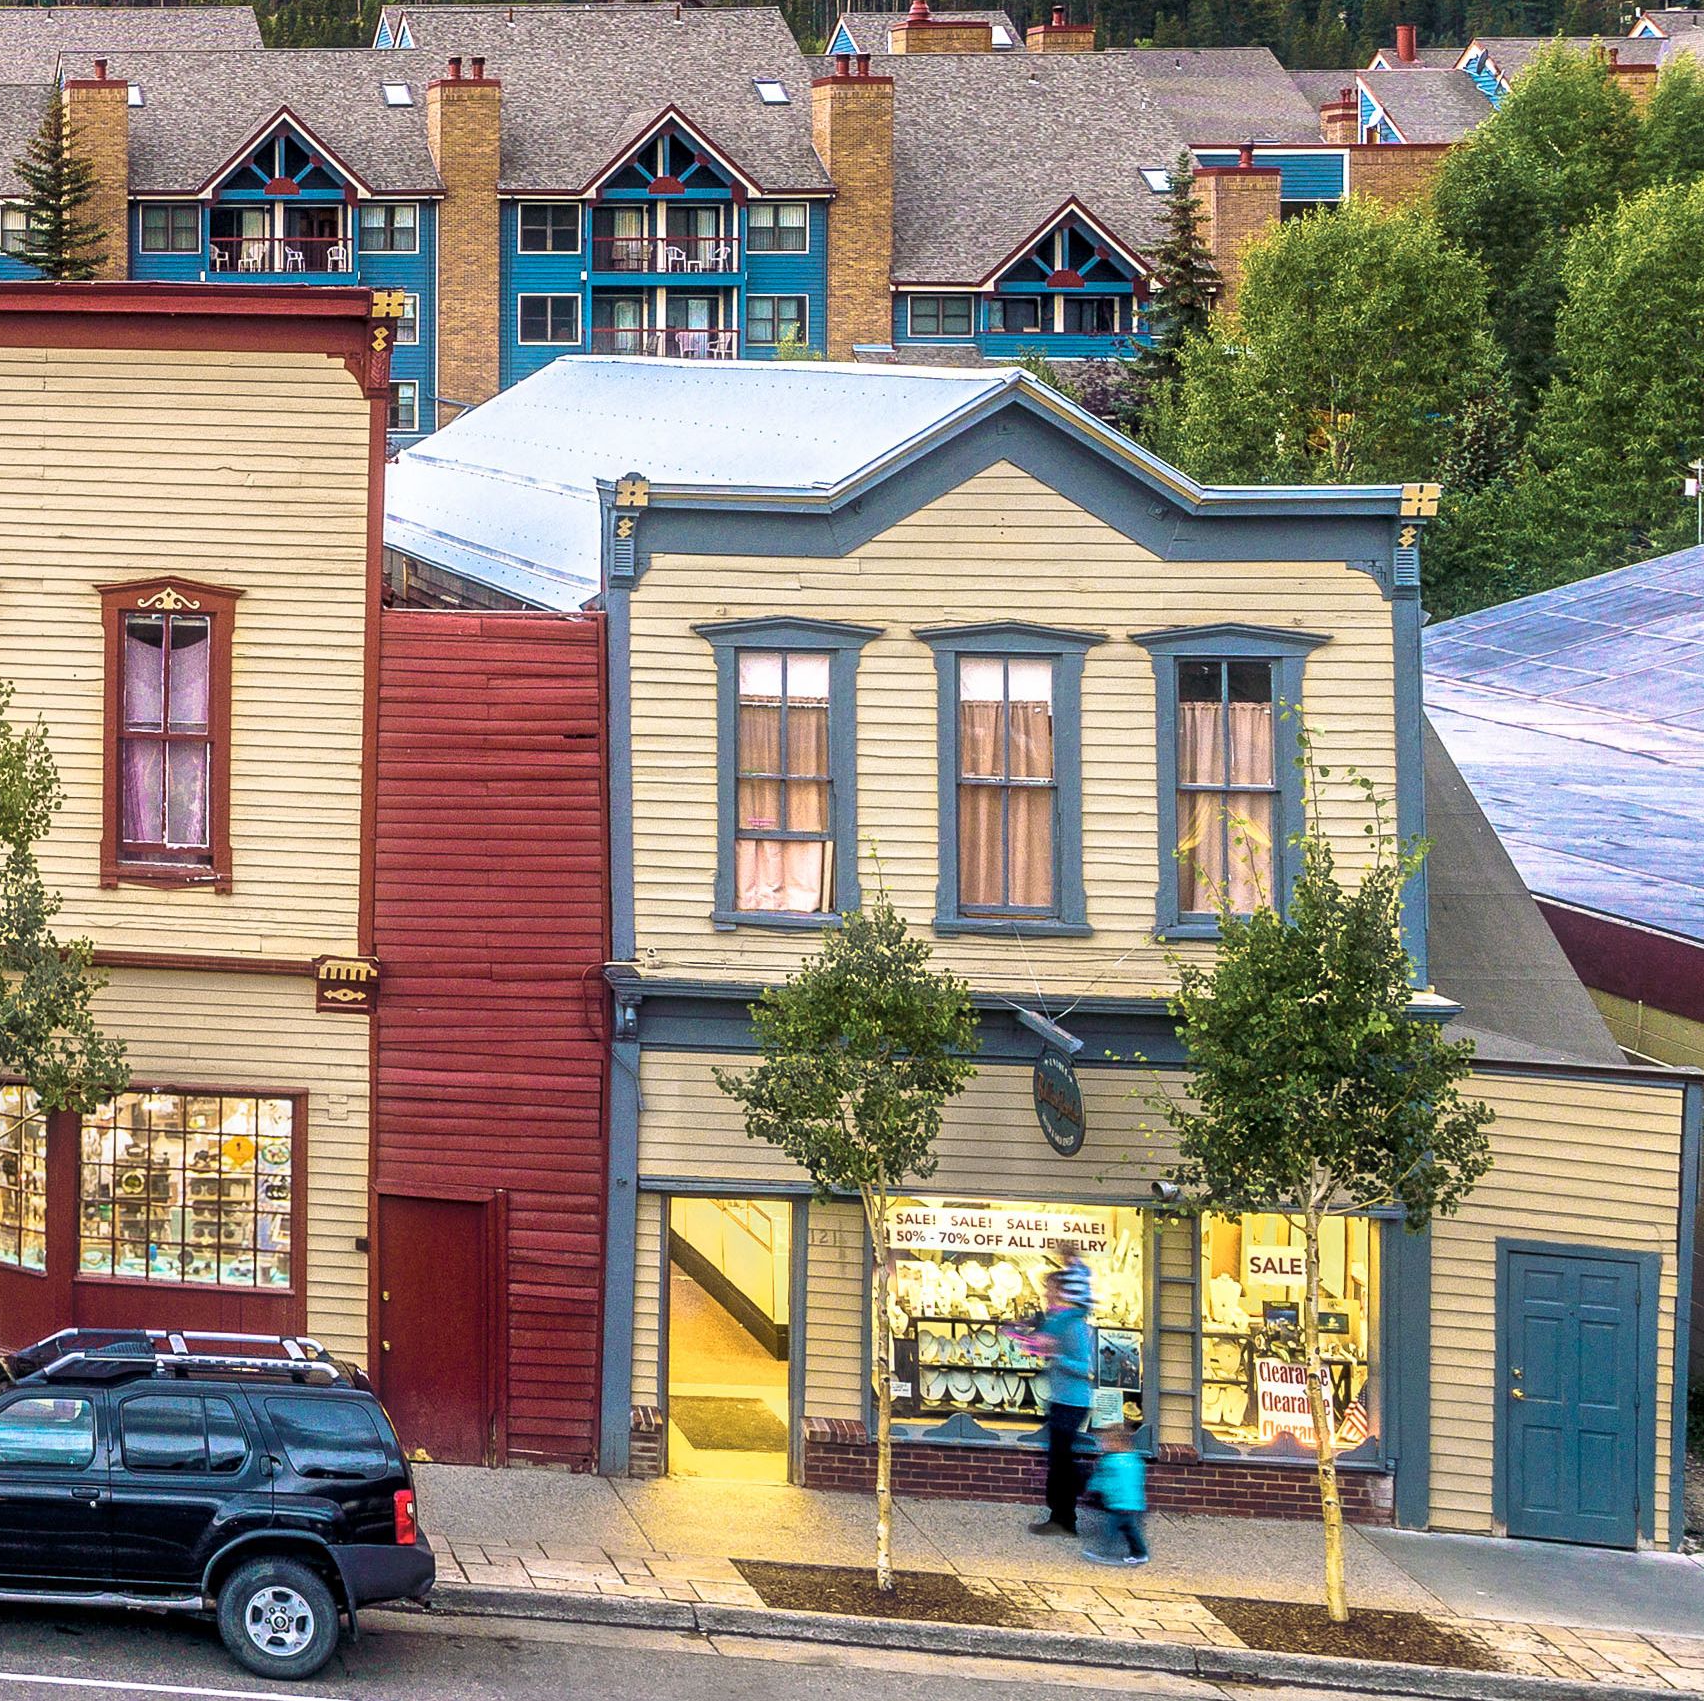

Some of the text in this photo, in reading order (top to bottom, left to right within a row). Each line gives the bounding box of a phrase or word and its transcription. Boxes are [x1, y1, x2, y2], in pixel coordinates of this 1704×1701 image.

[896, 1213, 1105, 1235] SALE! SALE! SALE! SALE!
[896, 1230, 926, 1243] 50%
[938, 1231, 970, 1245] 70%
[974, 1234, 1003, 1247] OFF
[1007, 1235, 1035, 1249] ALL
[1039, 1237, 1108, 1253] JEWELRY
[1259, 1362, 1329, 1387] Clearae
[1261, 1391, 1331, 1416] Clearane
